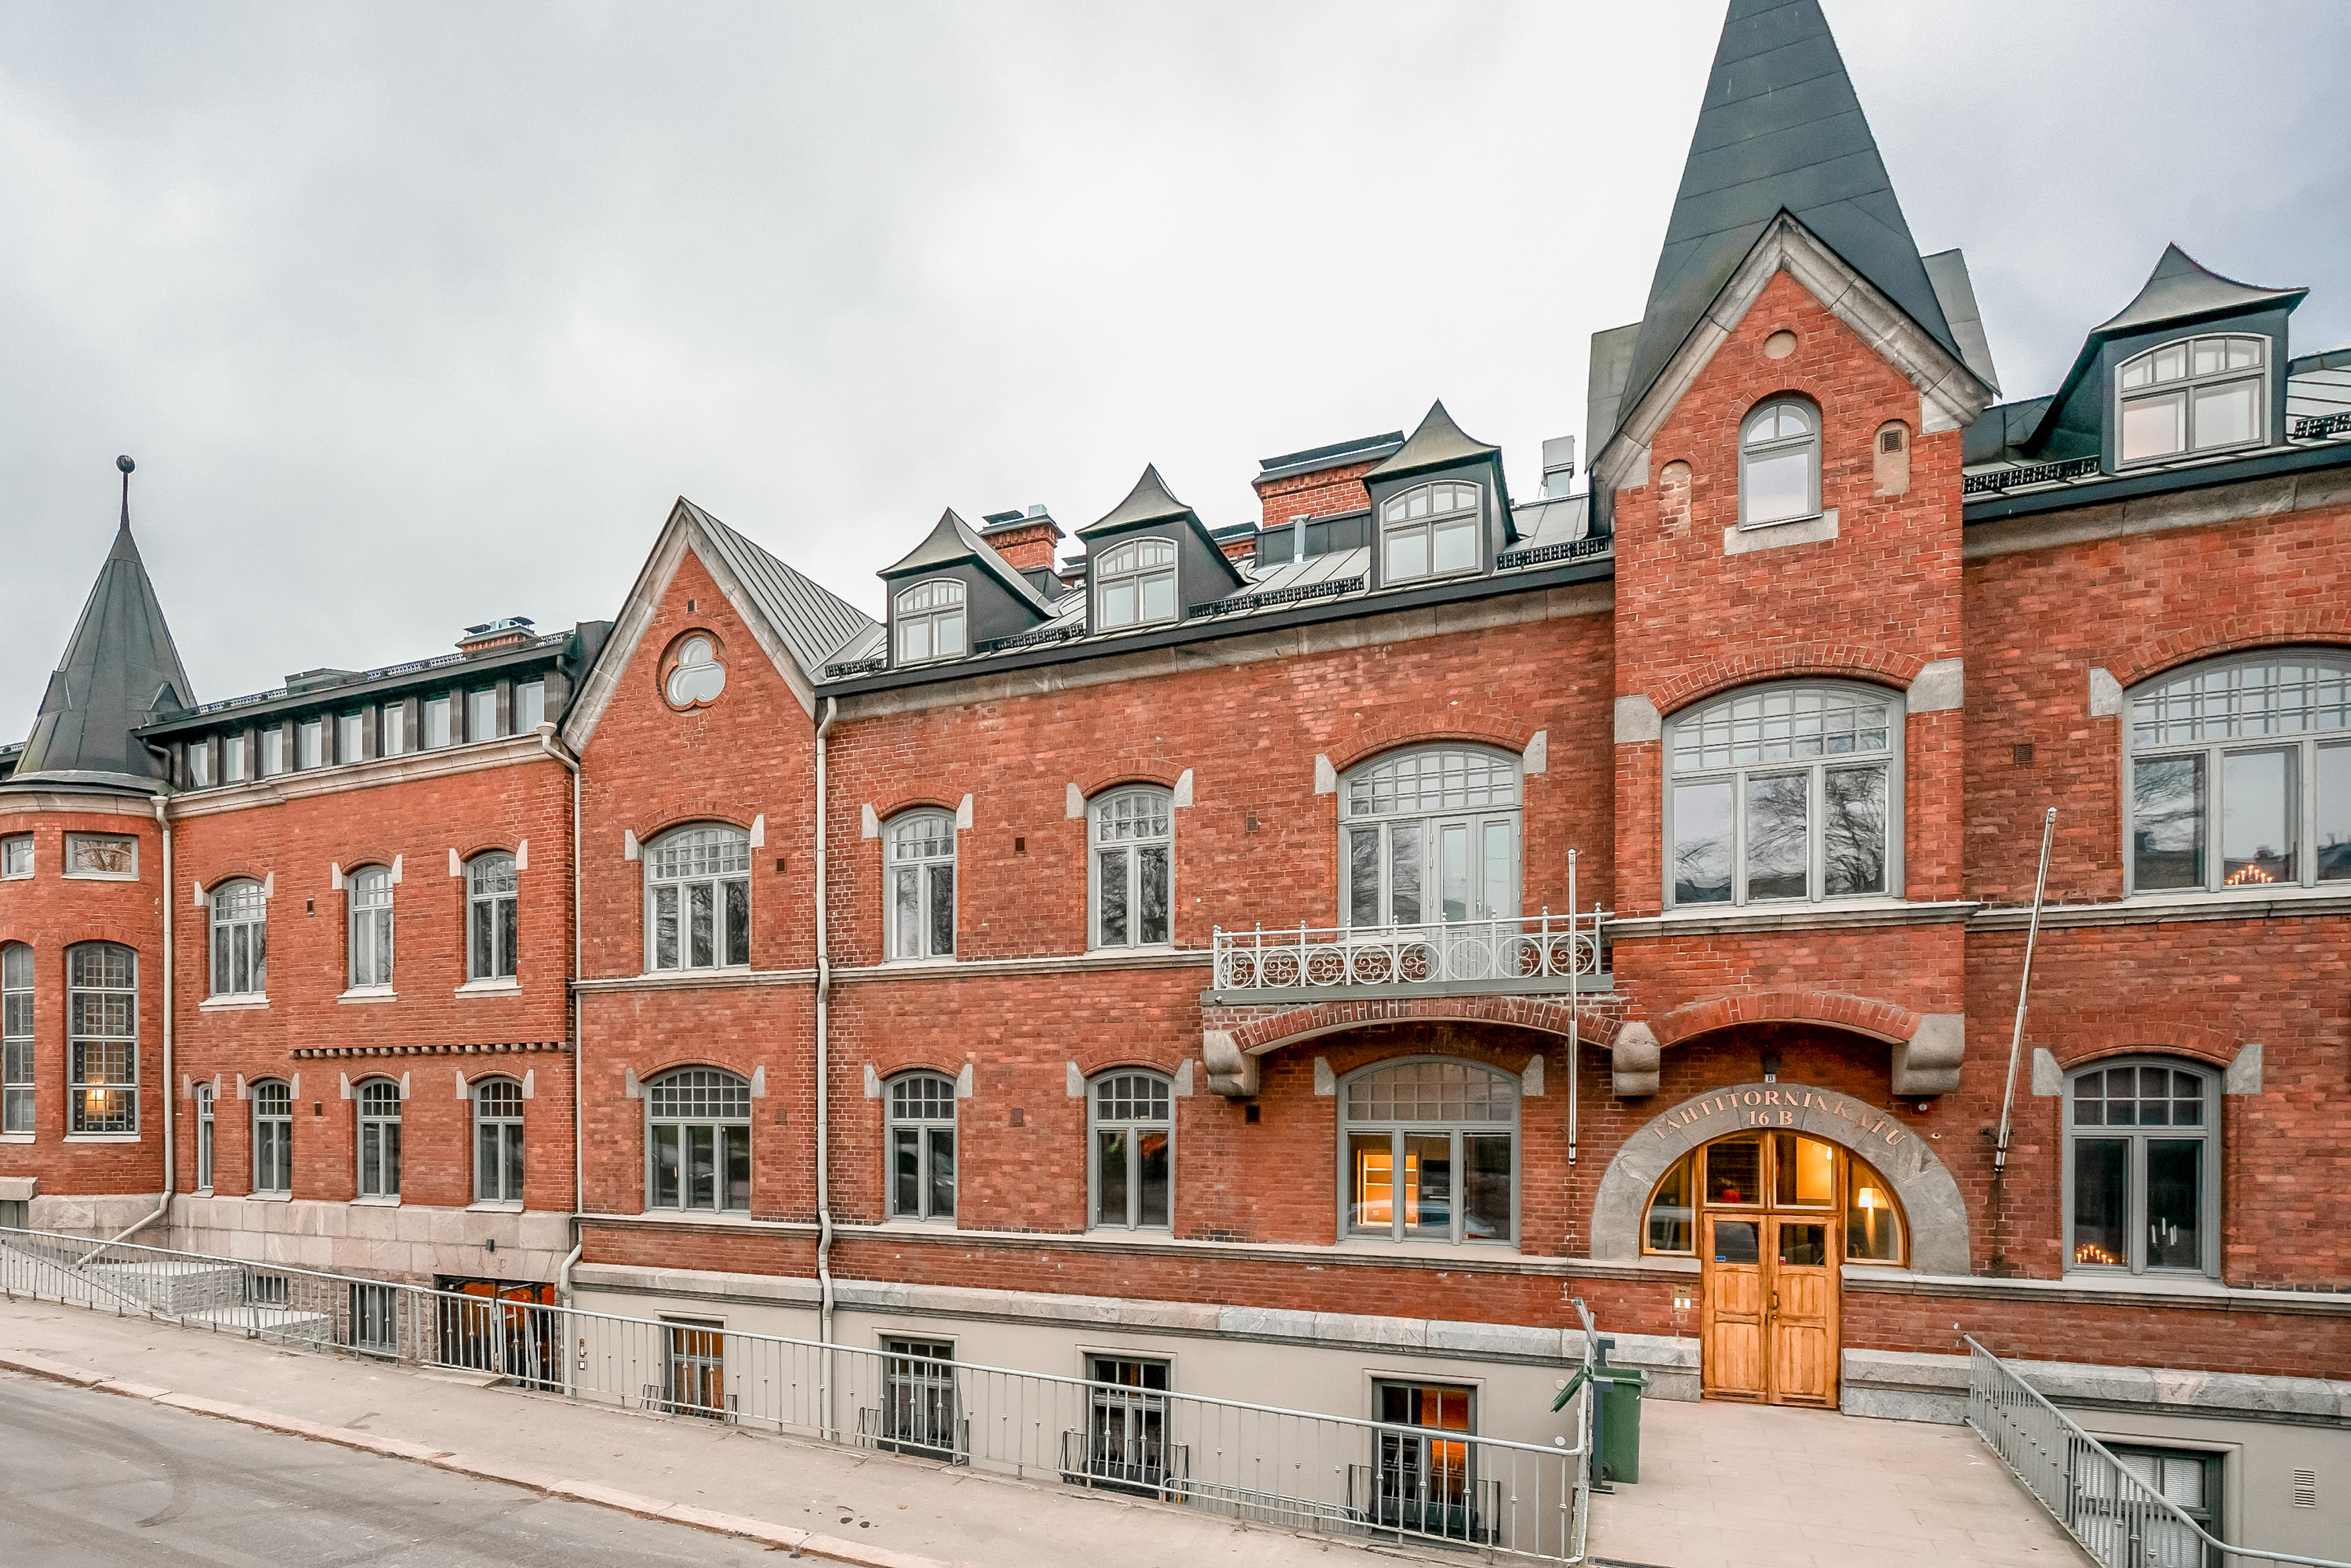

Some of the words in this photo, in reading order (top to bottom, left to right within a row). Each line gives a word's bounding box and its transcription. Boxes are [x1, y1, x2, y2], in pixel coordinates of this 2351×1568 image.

[1651, 1090, 1907, 1146] TÄHTITORNINKATU
[1748, 1110, 1770, 1126] 16
[1778, 1110, 1793, 1126] B
